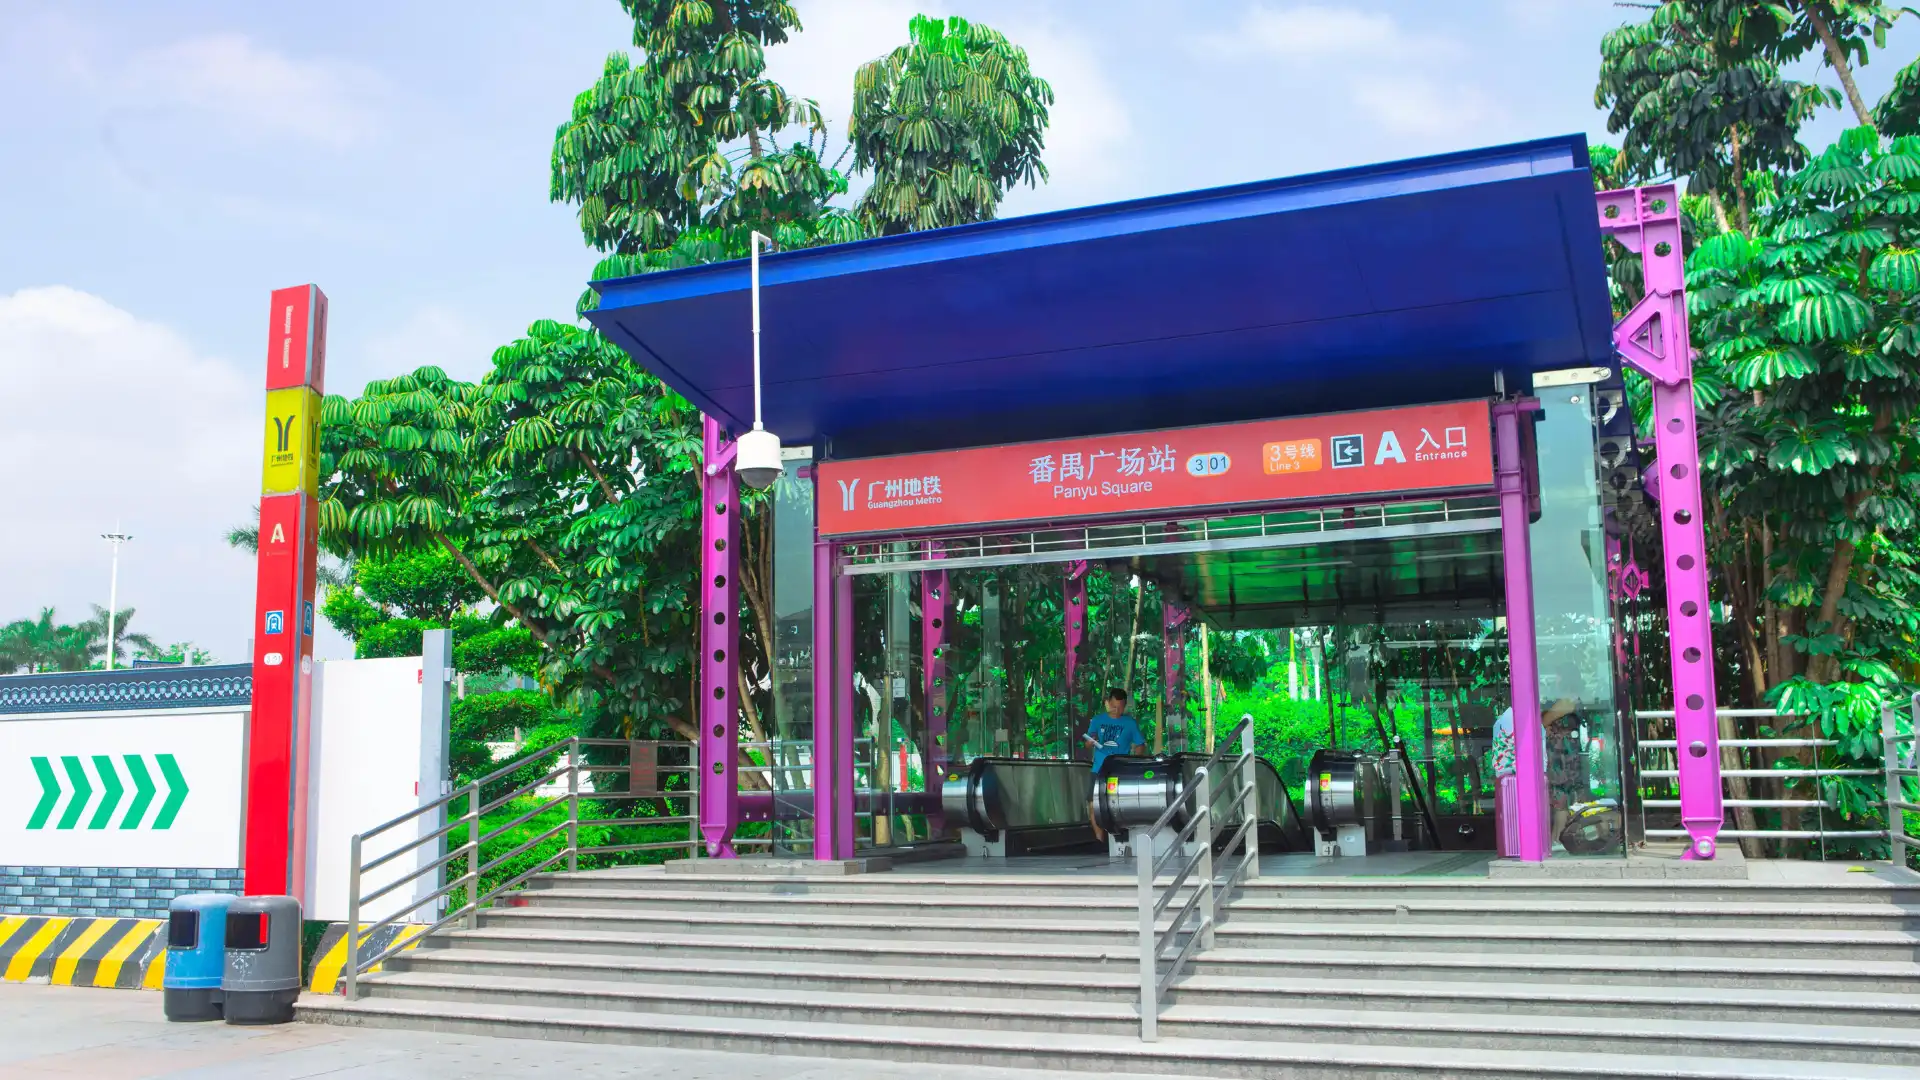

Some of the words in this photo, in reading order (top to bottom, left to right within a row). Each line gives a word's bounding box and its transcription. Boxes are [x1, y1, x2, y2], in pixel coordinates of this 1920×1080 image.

[1373, 430, 1407, 465] A
[1415, 426, 1467, 451] 入口
[1270, 444, 1316, 462] 3号线
[1415, 450, 1468, 462] Entrance
[1028, 444, 1177, 484] 番禺广场站
[1270, 462, 1292, 472] Line
[1294, 460, 1300, 470] 3
[867, 475, 942, 501] 广州地铁
[1053, 485, 1098, 500] Panyu
[1101, 481, 1153, 497] Square
[867, 499, 914, 510] Guangzhou
[915, 495, 943, 505] Metro
[270, 523, 286, 544] A
